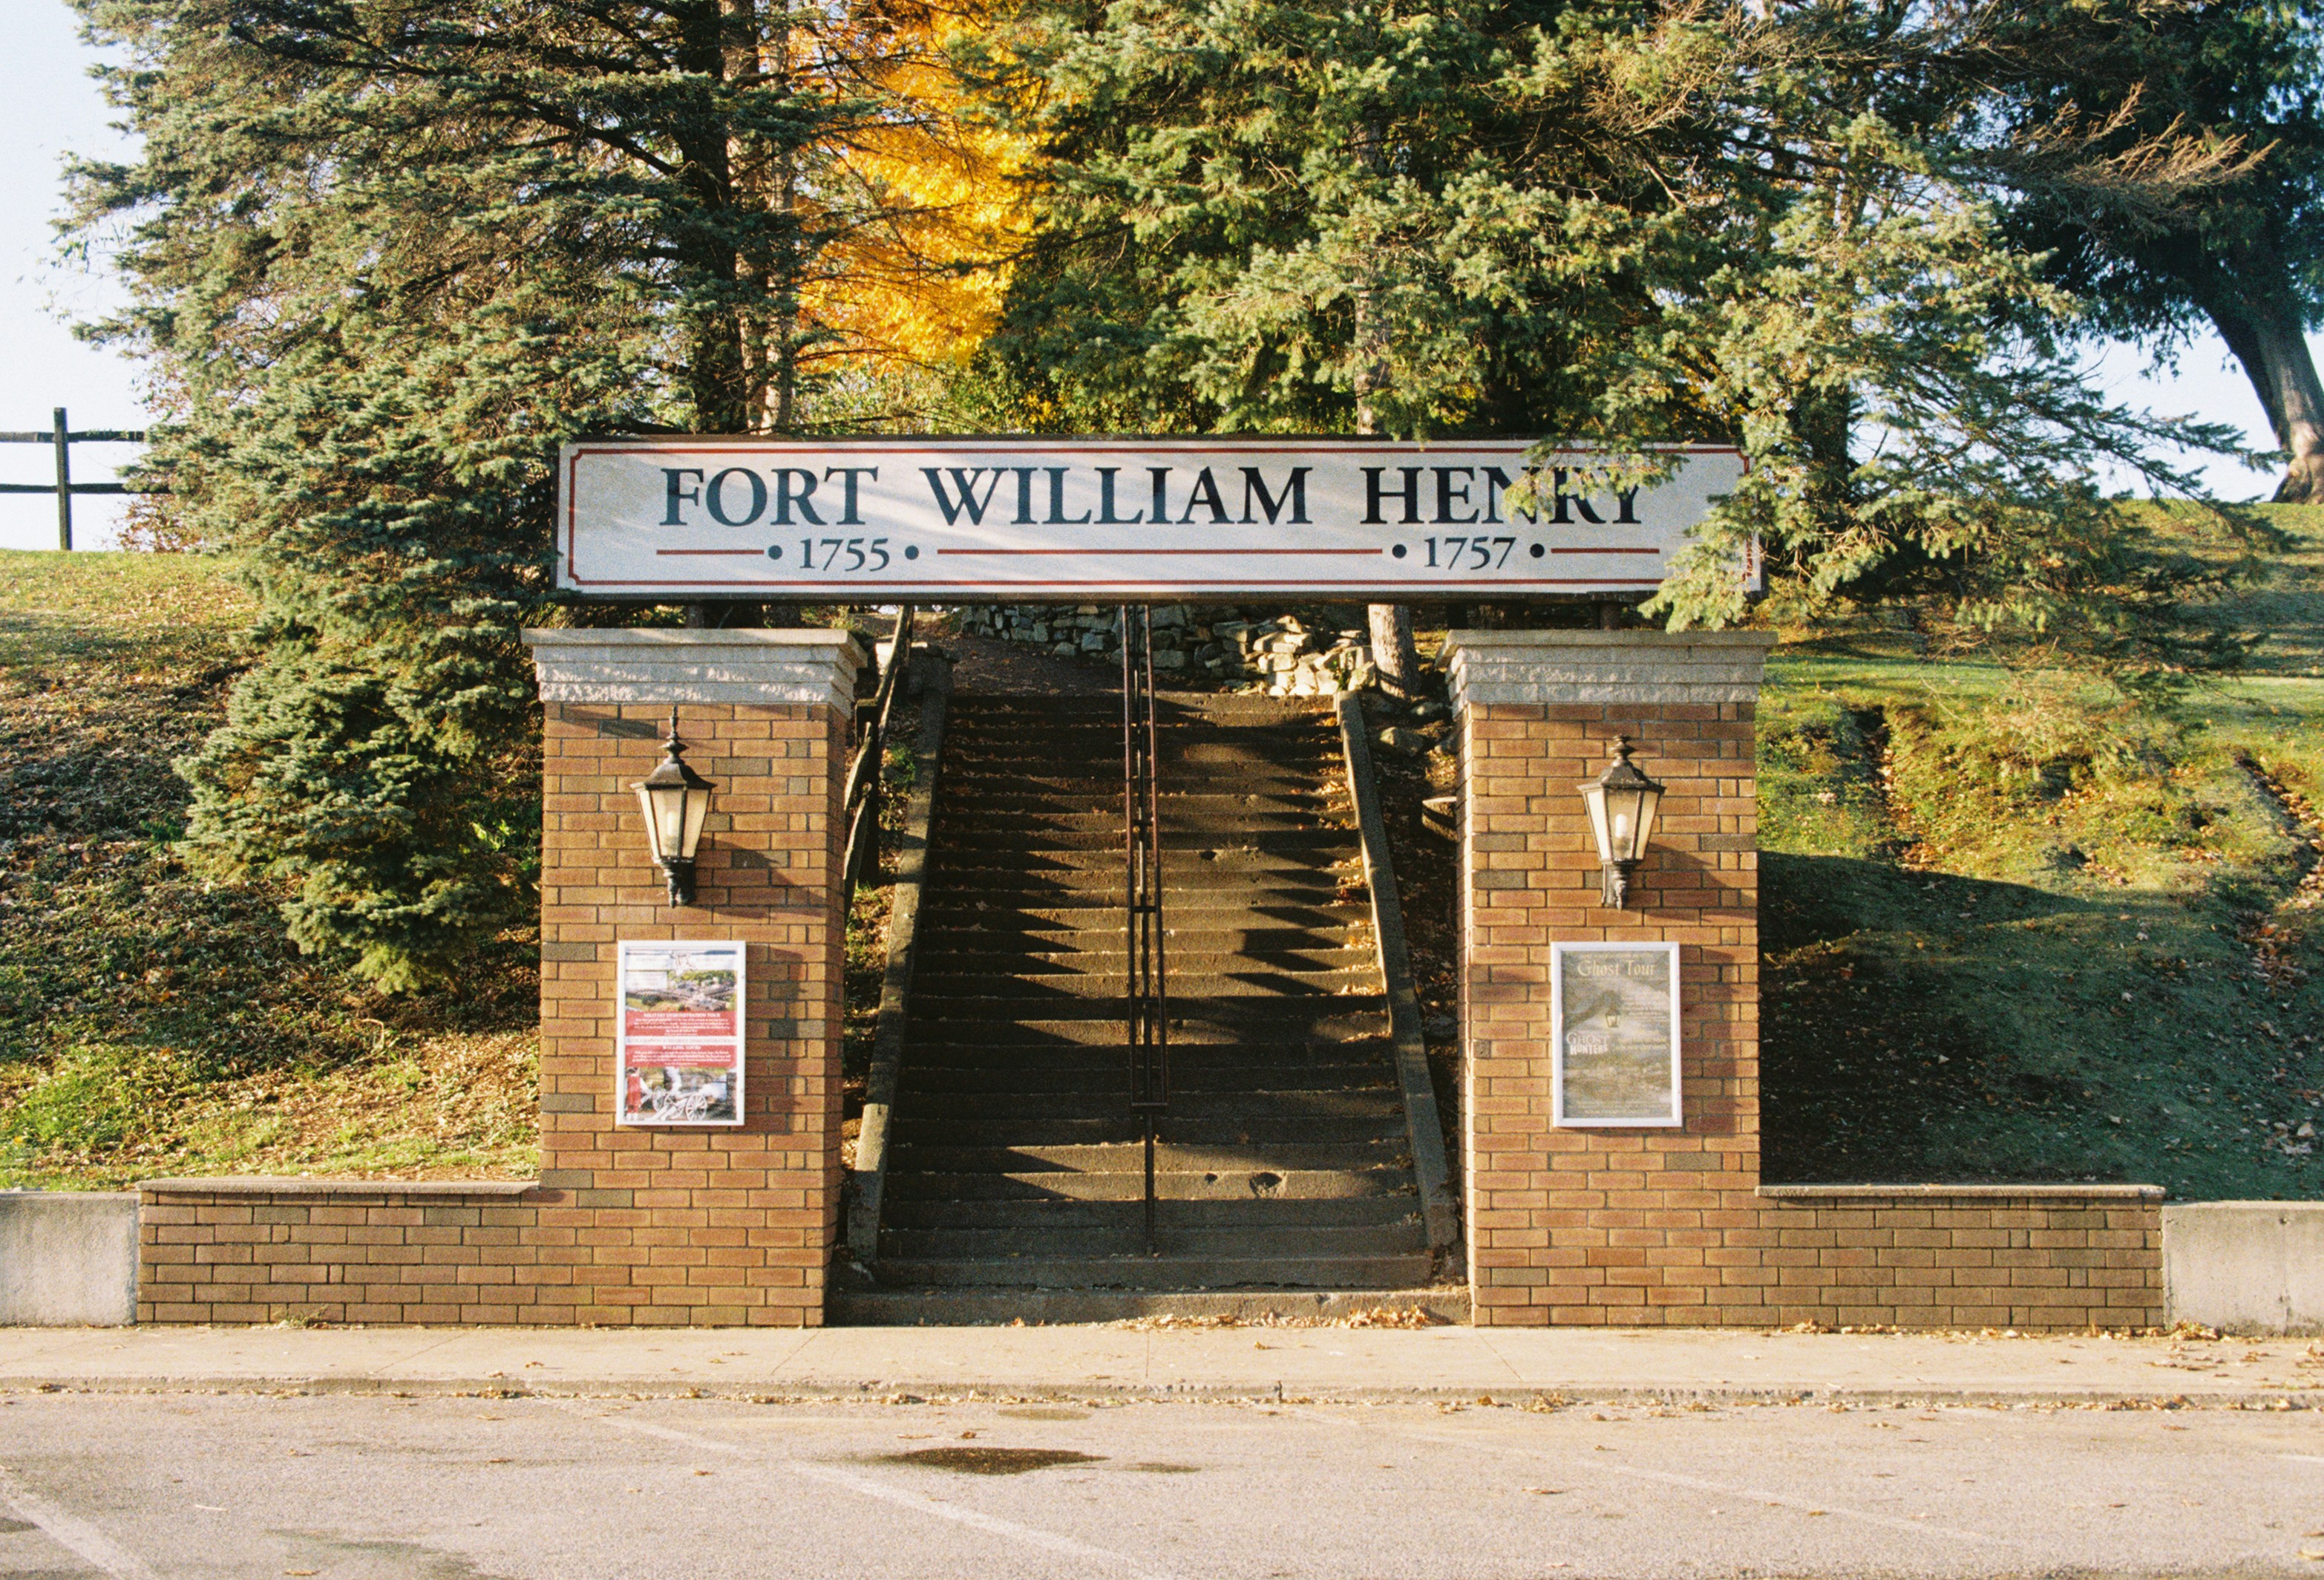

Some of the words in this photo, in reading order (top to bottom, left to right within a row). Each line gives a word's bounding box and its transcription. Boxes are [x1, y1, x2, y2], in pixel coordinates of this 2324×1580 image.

[659, 466, 879, 527] FORT
[918, 466, 1314, 526] WILLIAM
[799, 537, 891, 572] 1755
[1424, 536, 1516, 571] 1757
[1577, 959, 1620, 976] Ghost
[1626, 959, 1656, 976] Tour
[1570, 1043, 1608, 1055] HUNTERS
